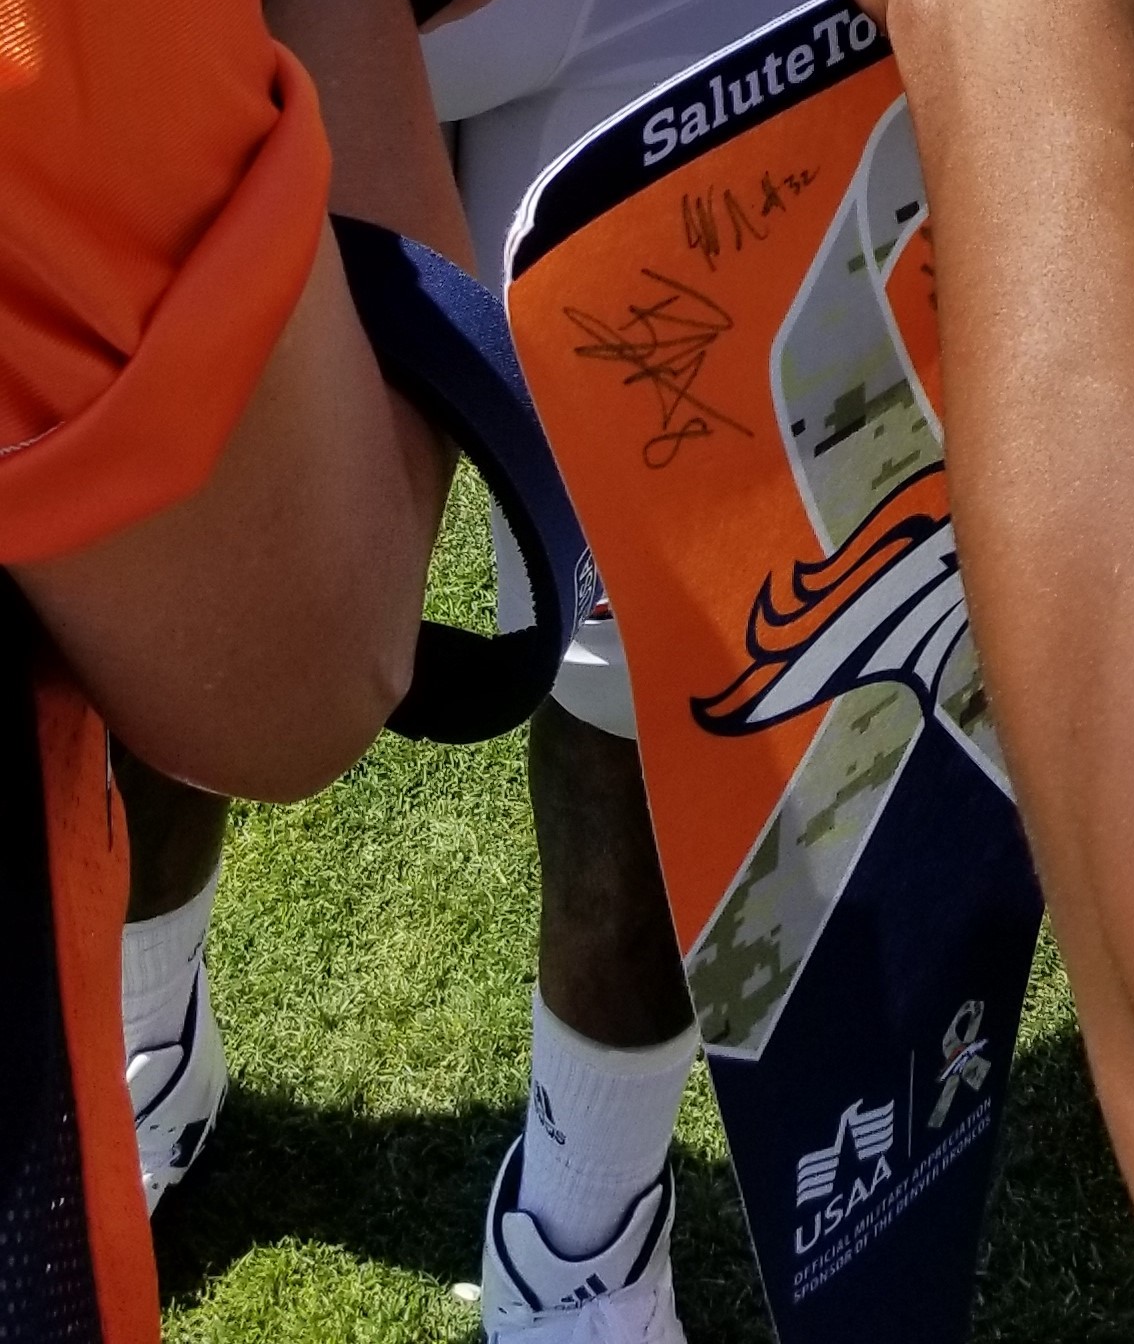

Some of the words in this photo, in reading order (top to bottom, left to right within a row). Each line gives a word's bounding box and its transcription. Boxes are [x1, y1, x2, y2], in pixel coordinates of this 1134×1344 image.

[642, 8, 880, 167] SaluteTo
[795, 1153, 892, 1254] USAA
[794, 1235, 851, 1286] OFFICIAL
